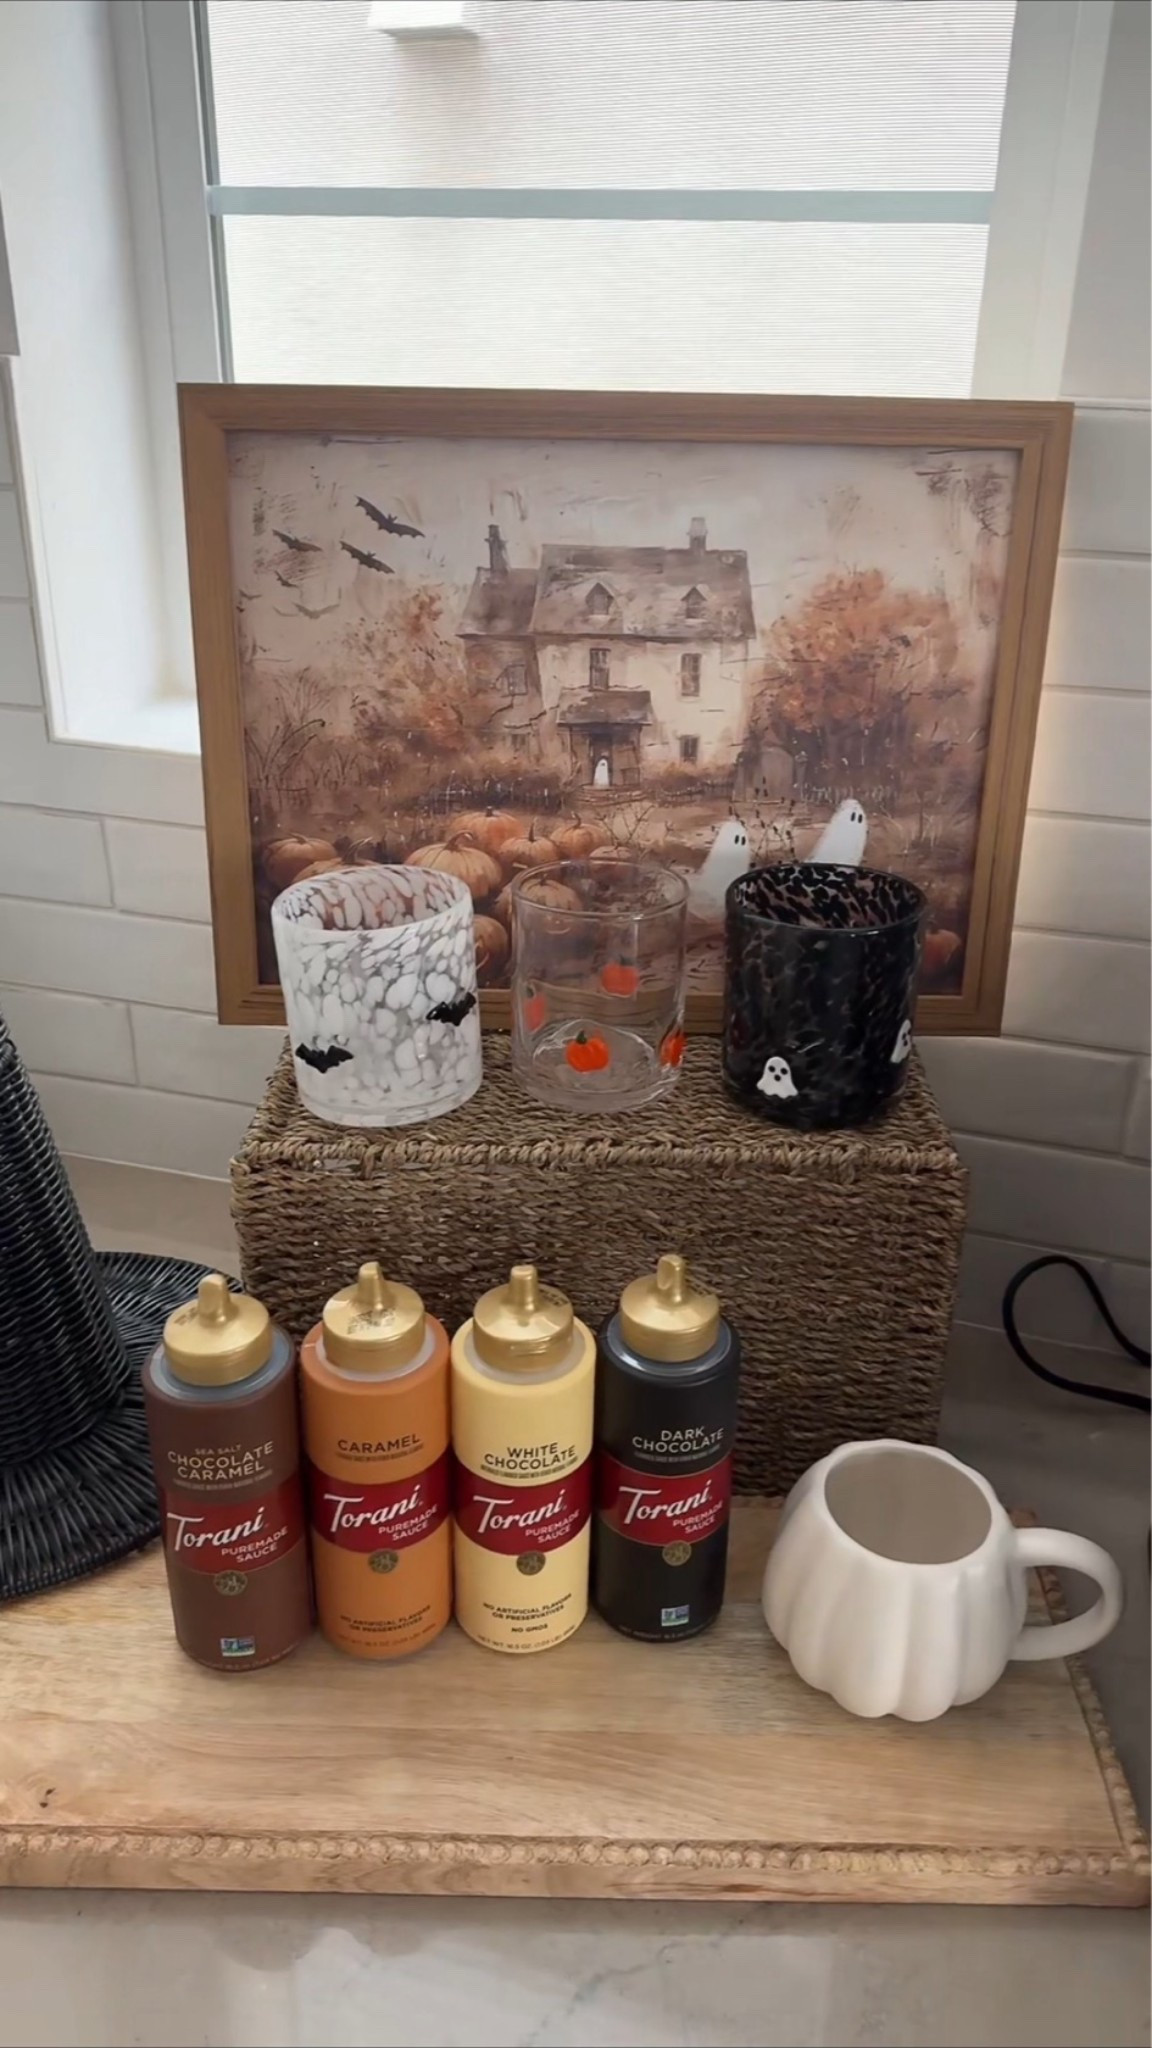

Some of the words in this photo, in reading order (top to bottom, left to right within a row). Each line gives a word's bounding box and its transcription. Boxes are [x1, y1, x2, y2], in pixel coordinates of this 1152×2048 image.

[338, 1433, 421, 1453] CARAMEL
[632, 1428, 724, 1453] CHOCOLATE
[661, 1426, 704, 1441] DARK
[167, 1440, 274, 1469] CHOCOLATE
[484, 1445, 575, 1470] CHOCOLATE
[507, 1442, 558, 1458] WHITE
[177, 1461, 265, 1481] CARAMEL
[324, 1484, 421, 1532] Torani
[473, 1489, 565, 1533] Torani
[619, 1479, 711, 1524] Torani
[167, 1506, 265, 1551] Torani
[379, 1504, 437, 1534] PUREMADE
[392, 1520, 428, 1540] SAUCE
[221, 1525, 288, 1556] PUREMADE
[538, 1524, 571, 1543] SAUCE
[236, 1543, 278, 1563] SAUCE
